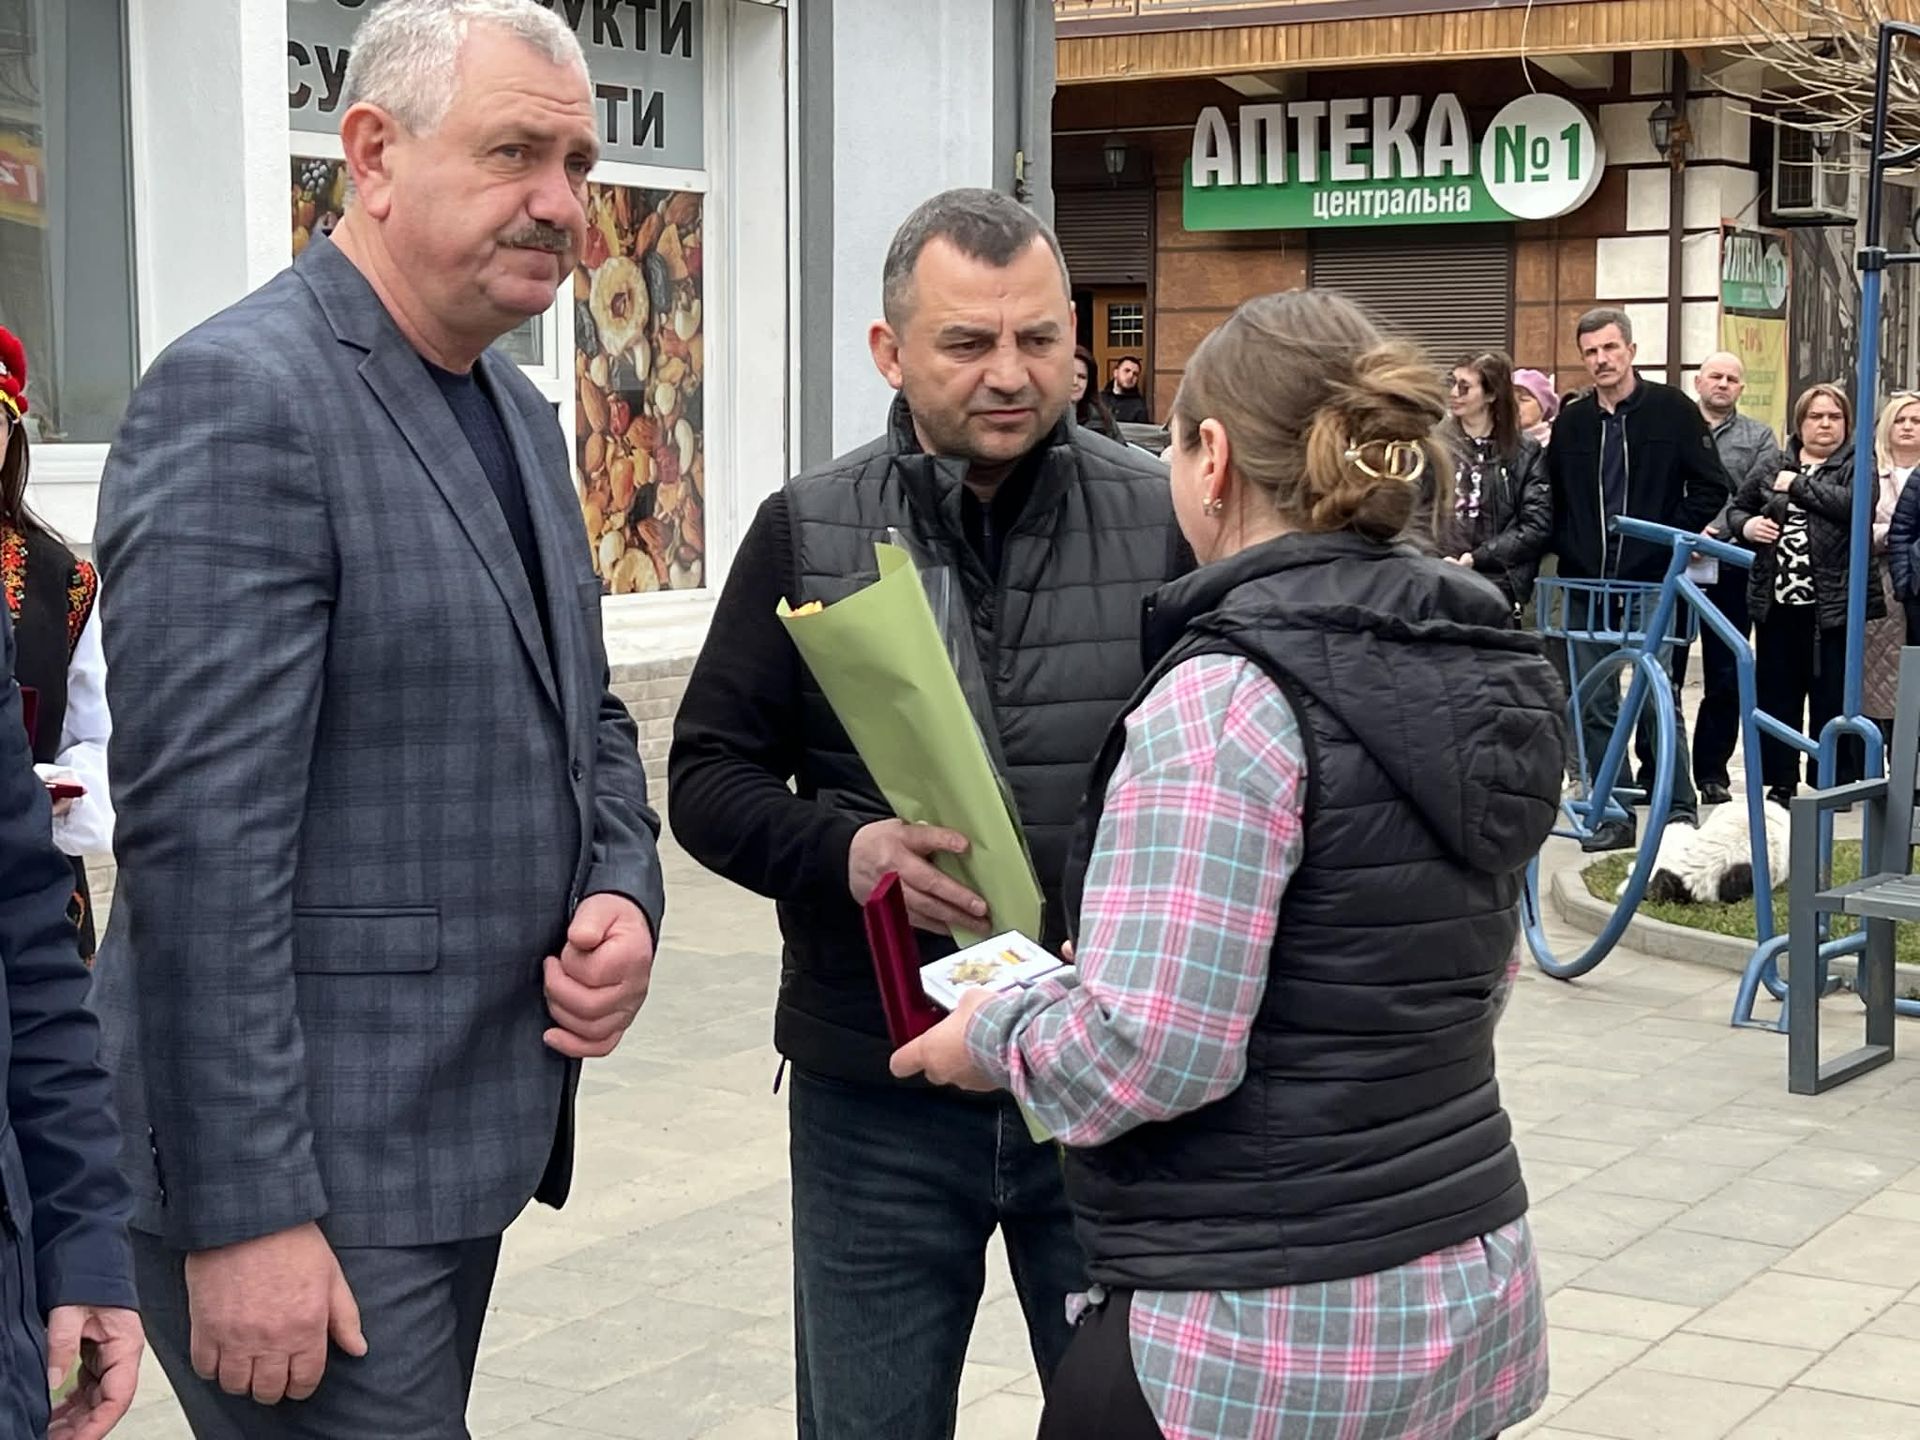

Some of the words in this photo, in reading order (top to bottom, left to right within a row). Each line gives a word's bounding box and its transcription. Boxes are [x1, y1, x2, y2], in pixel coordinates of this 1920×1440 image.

[541, 0, 692, 58] УКТИ
[288, 40, 350, 113] СУ
[595, 83, 664, 149] ТИ
[1191, 92, 1474, 187] АПТЕКА
[1312, 184, 1472, 218] центральна
